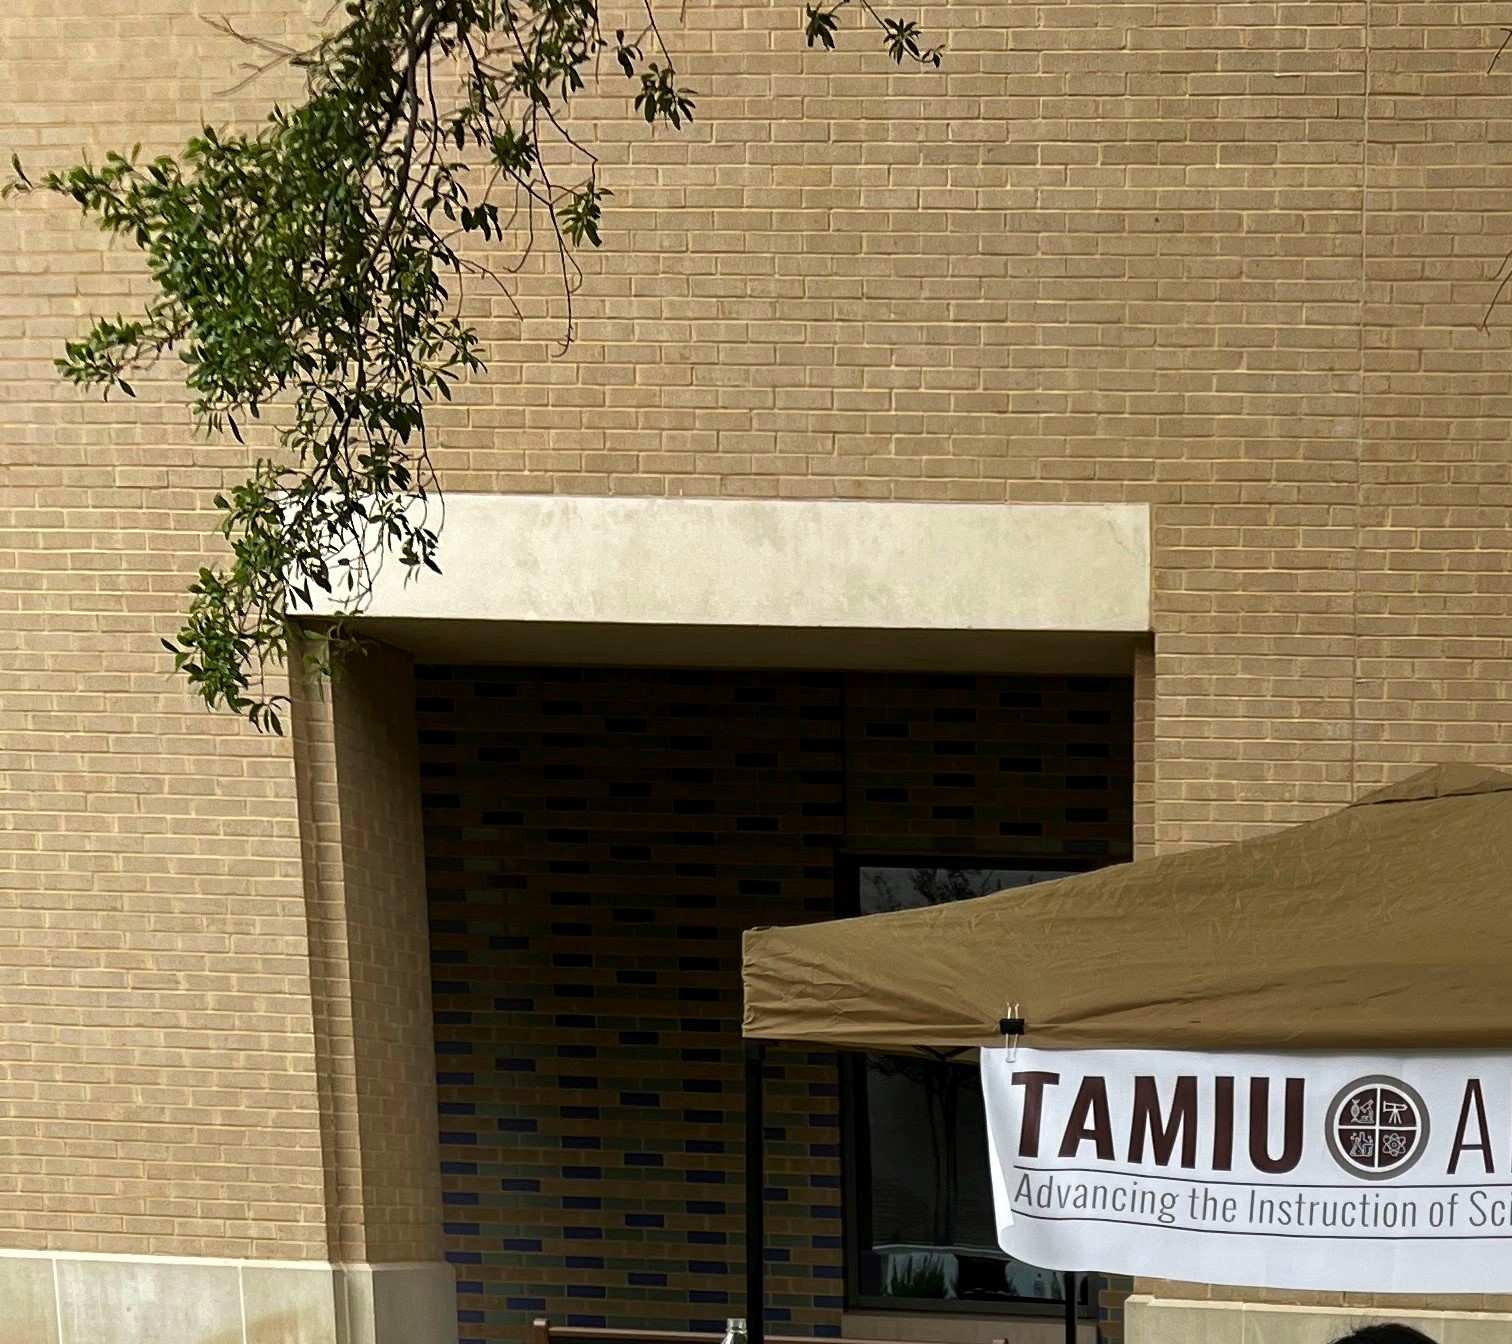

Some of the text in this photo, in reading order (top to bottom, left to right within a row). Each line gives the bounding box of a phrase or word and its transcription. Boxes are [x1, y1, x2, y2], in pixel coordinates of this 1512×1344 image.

[1012, 1070, 1304, 1174] TAMIU
[1014, 1174, 1177, 1226] Advancing
[1189, 1185, 1238, 1225] the
[1248, 1188, 1417, 1228] Instruction
[1429, 1190, 1459, 1228] of
